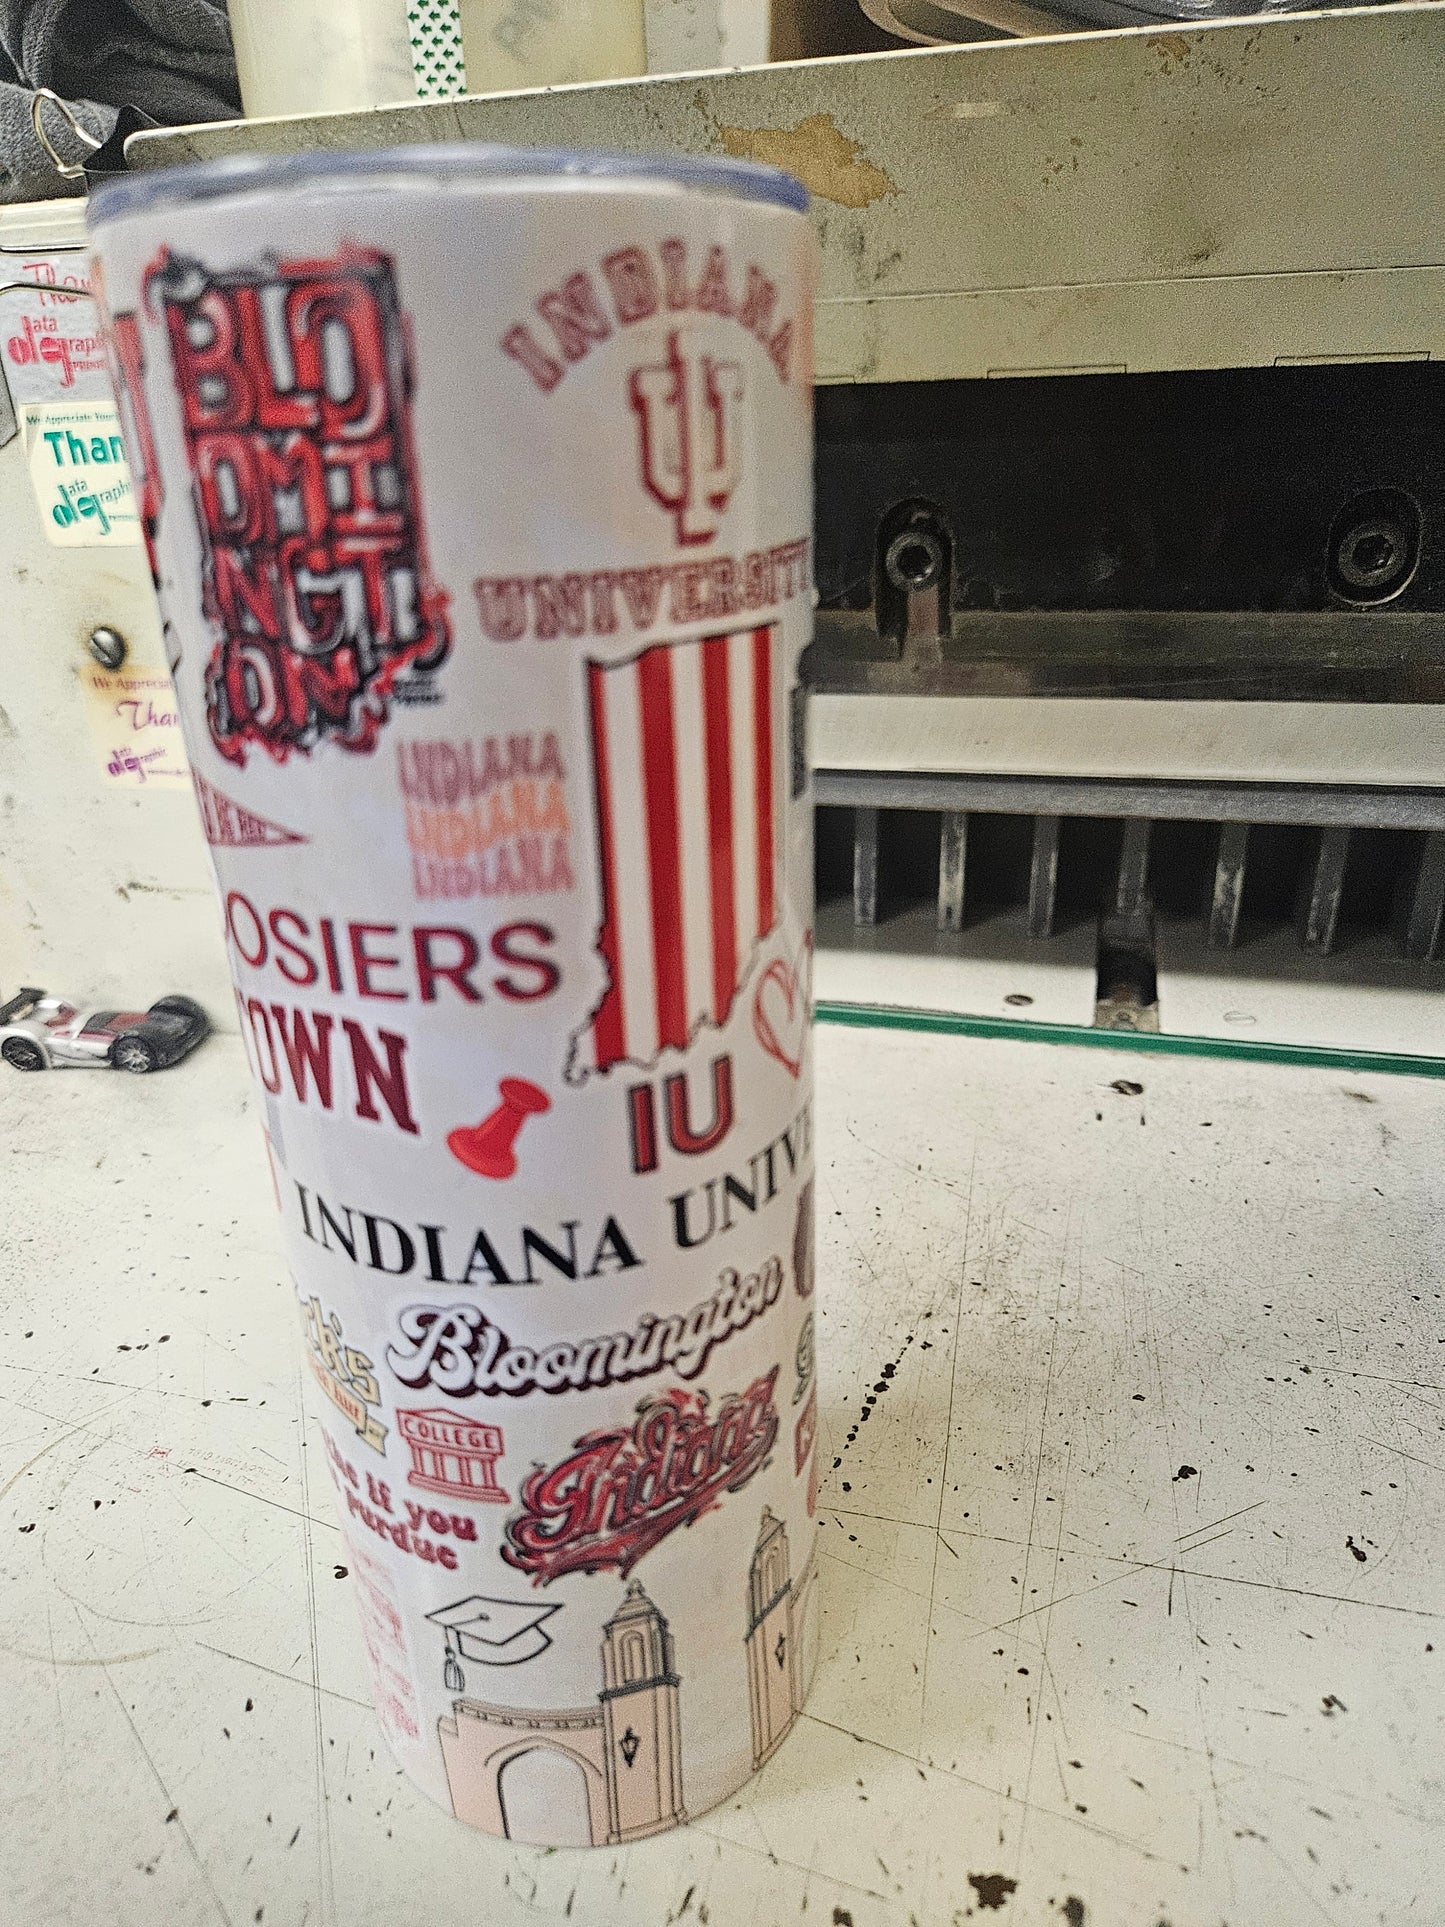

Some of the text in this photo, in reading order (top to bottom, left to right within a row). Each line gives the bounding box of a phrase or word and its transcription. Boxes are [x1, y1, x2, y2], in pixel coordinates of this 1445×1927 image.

[627, 1053, 735, 1176] IU
[294, 1178, 644, 1287] INDIANA
[385, 1254, 785, 1399] Bloomington
[401, 1416, 498, 1451] COLLEGE
[403, 1497, 478, 1542] you
